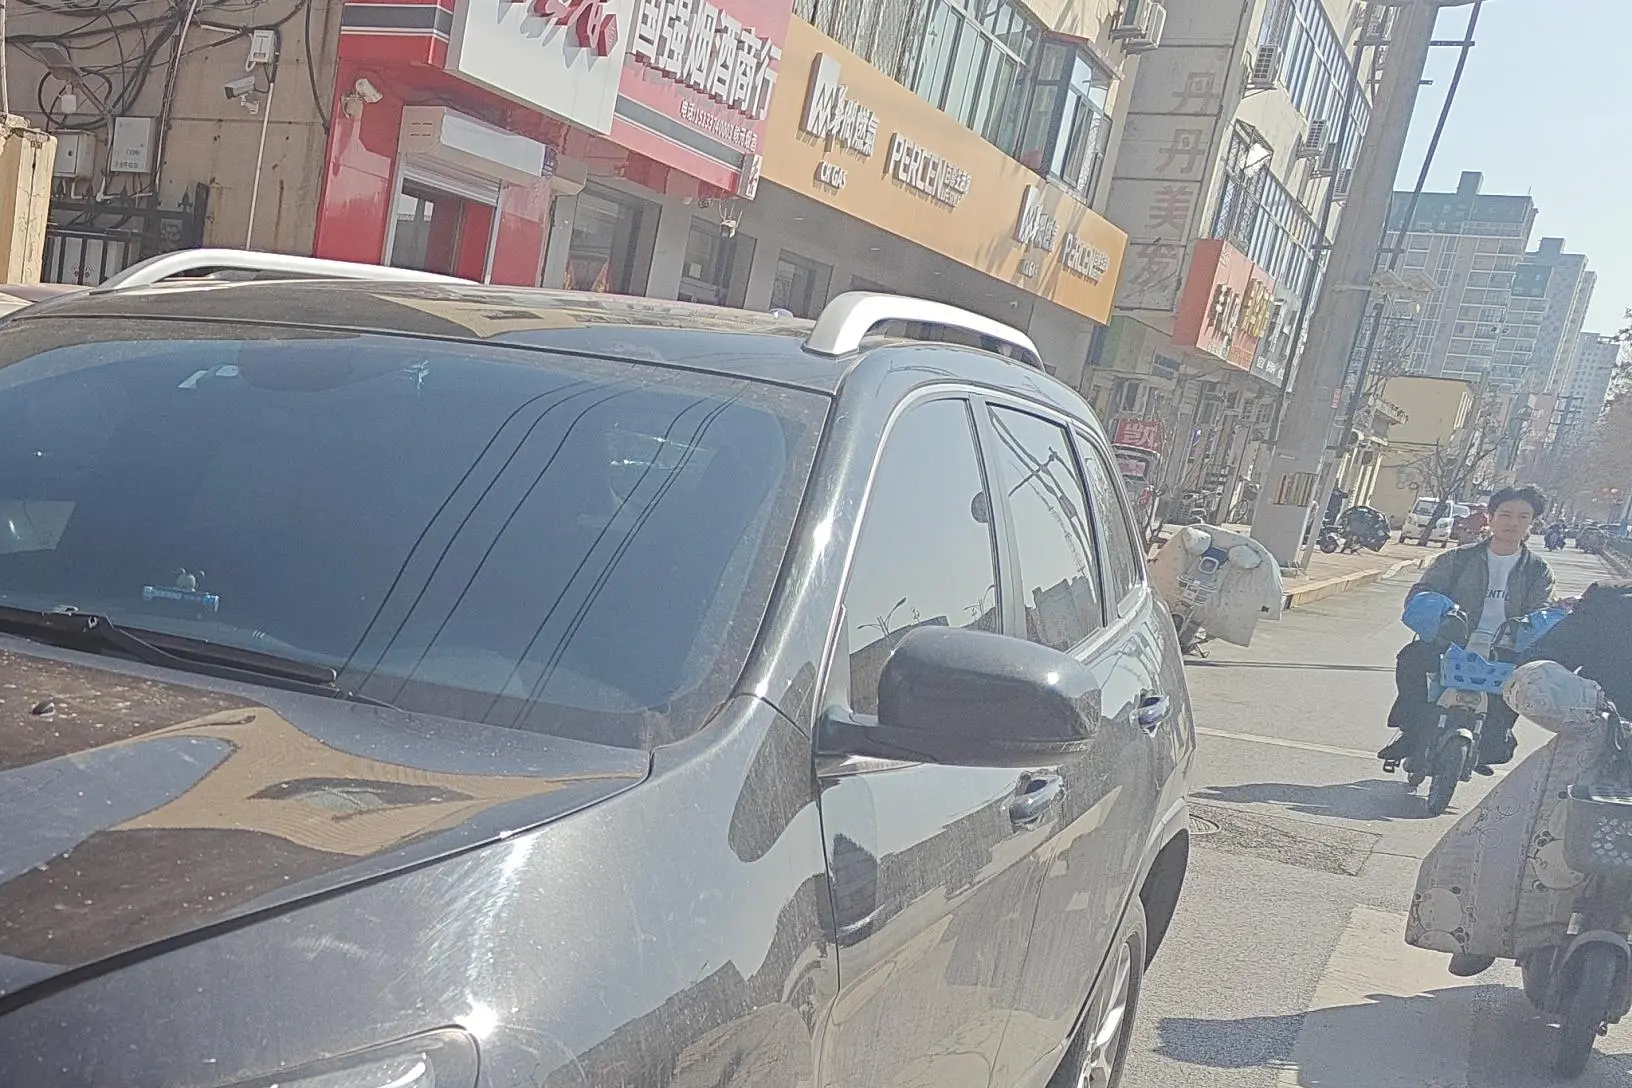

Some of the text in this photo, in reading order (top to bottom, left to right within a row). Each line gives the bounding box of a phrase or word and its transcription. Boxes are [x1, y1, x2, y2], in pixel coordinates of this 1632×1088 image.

[632, 0, 782, 120] 国强烟酒商行
[831, 165, 848, 189] GAS
[888, 131, 946, 200] PERCEN
